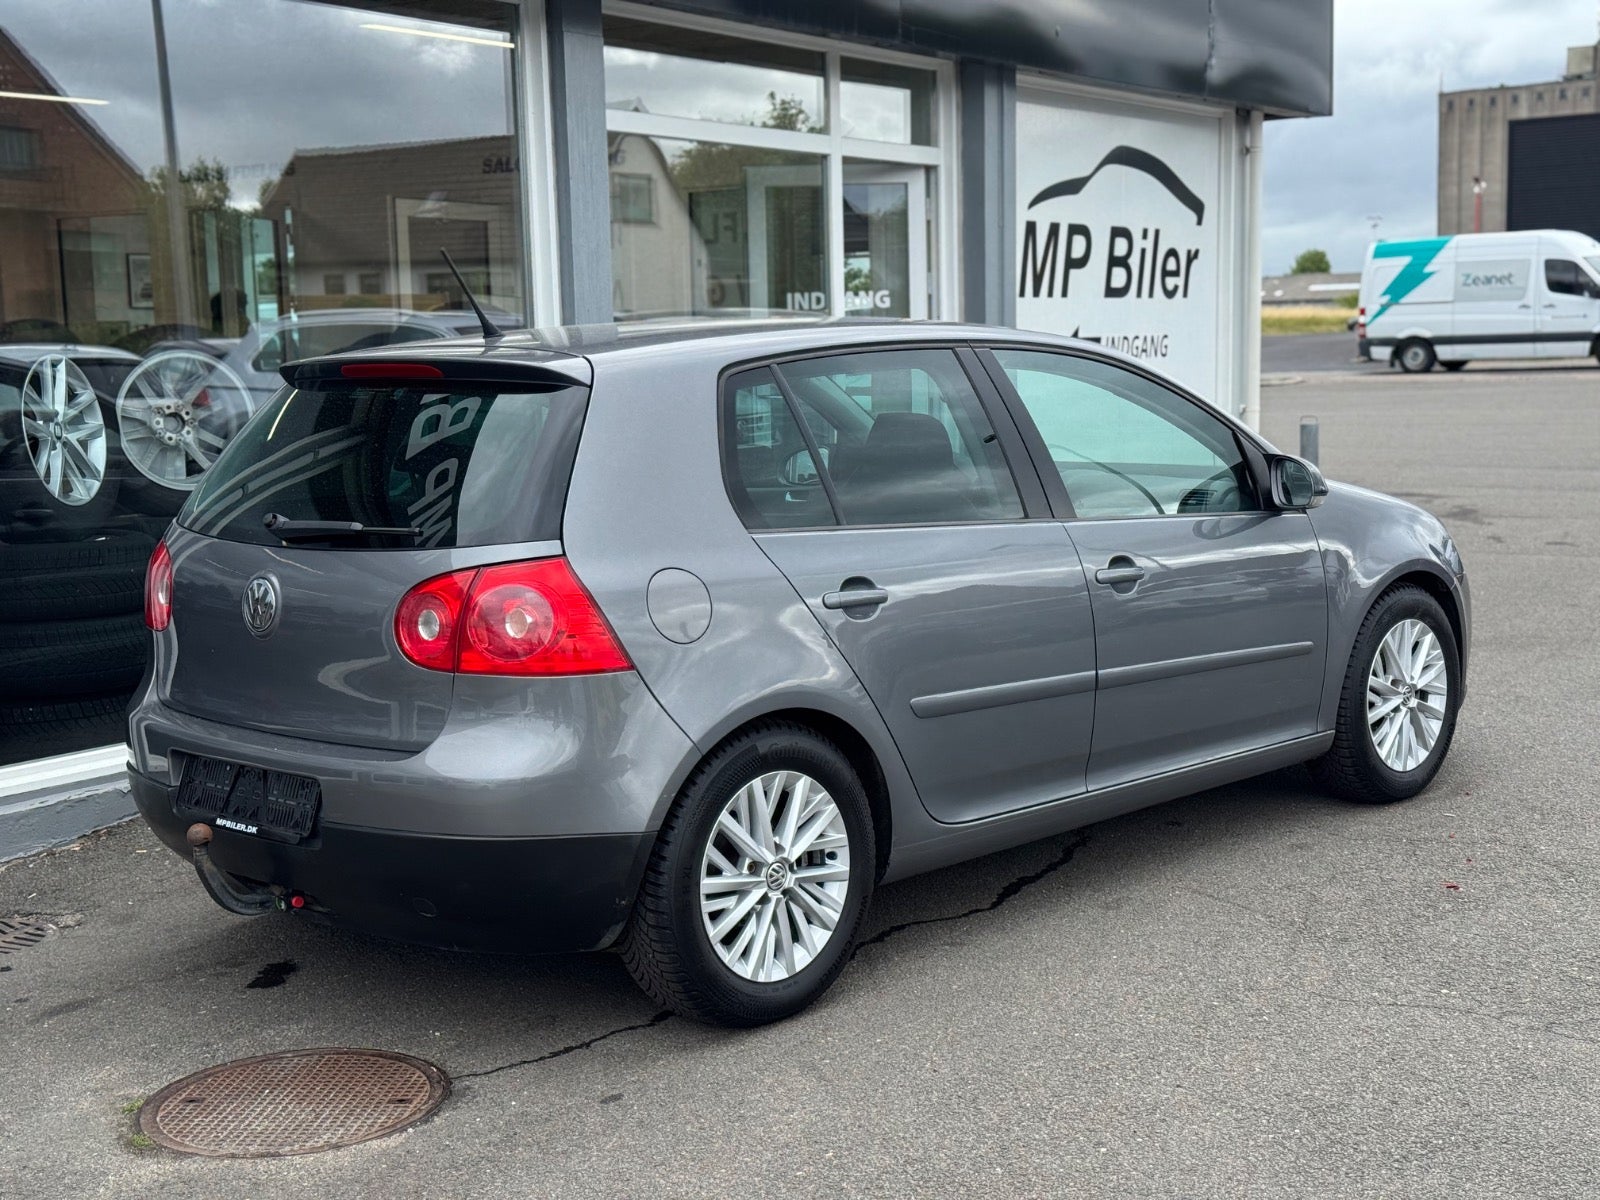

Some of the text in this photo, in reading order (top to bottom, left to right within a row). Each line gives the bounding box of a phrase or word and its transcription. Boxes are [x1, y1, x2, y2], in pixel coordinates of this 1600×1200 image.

[1018, 220, 1200, 299] MP Biler
[1461, 271, 1514, 287] Zeanet
[785, 289, 892, 311] INDANG
[215, 817, 259, 835] MPBILER.DK
